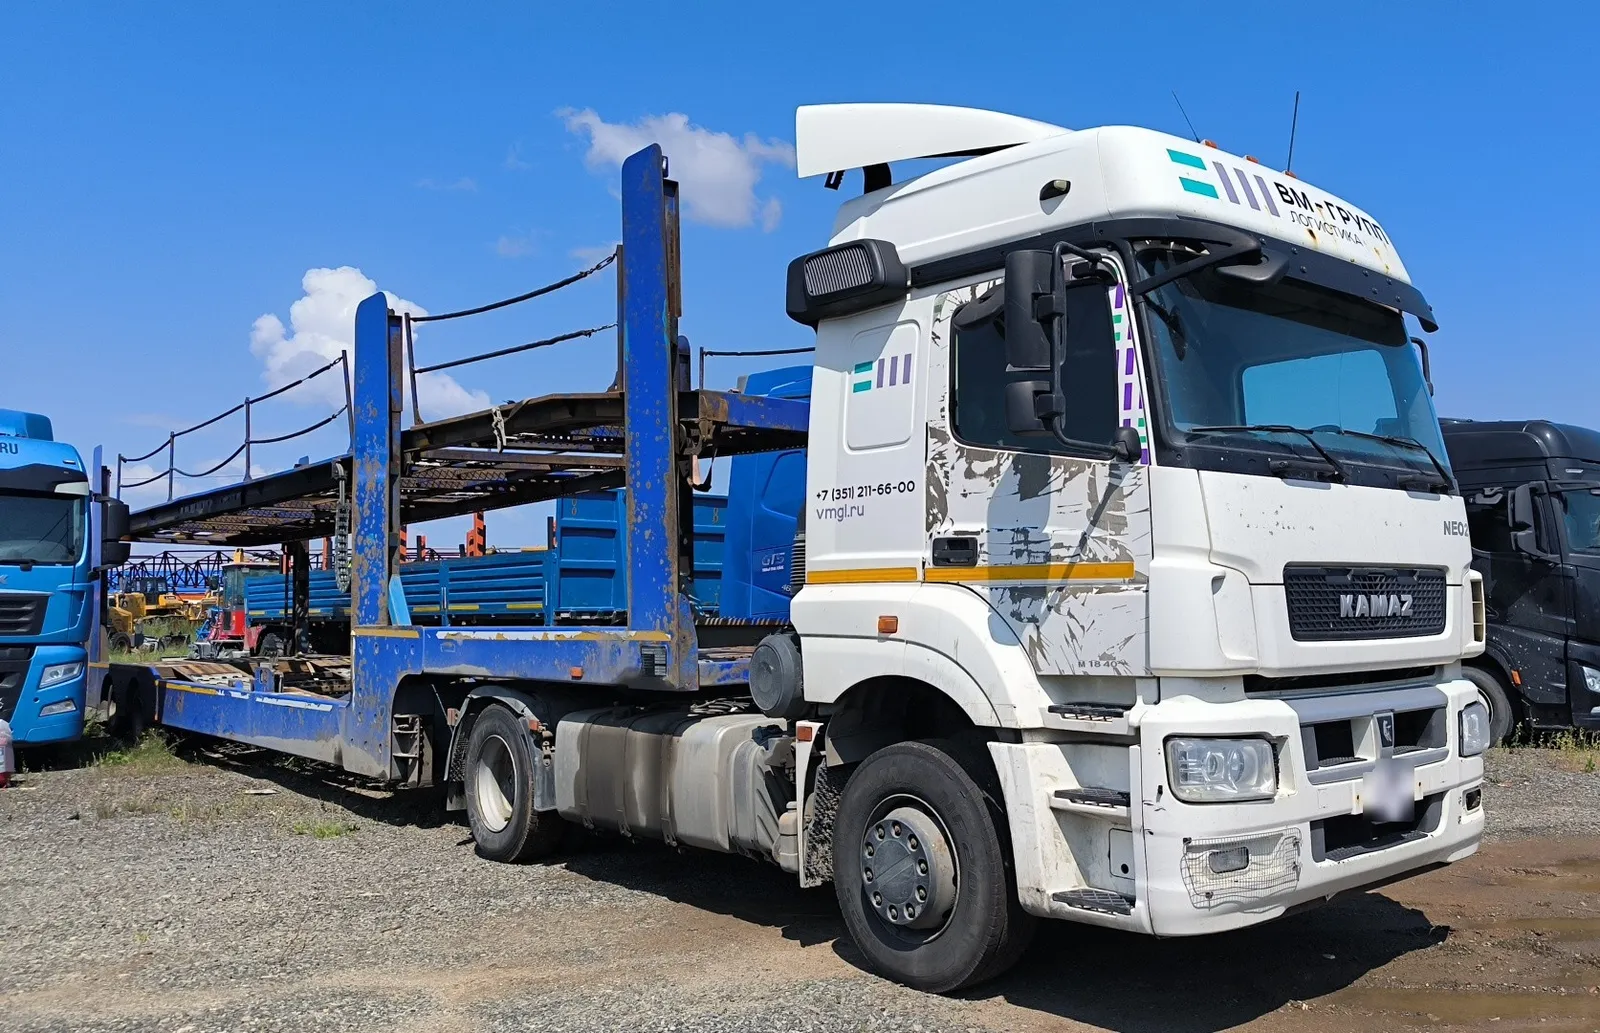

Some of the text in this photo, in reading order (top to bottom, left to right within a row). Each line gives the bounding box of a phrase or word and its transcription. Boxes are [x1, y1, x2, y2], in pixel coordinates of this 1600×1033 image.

[1290, 210, 1364, 247] ЛОГИСТИКА
[816, 480, 916, 502] +7 (351) 211-66-00
[816, 503, 865, 522] vmgl.ru
[1340, 594, 1414, 618] KAMAZ
